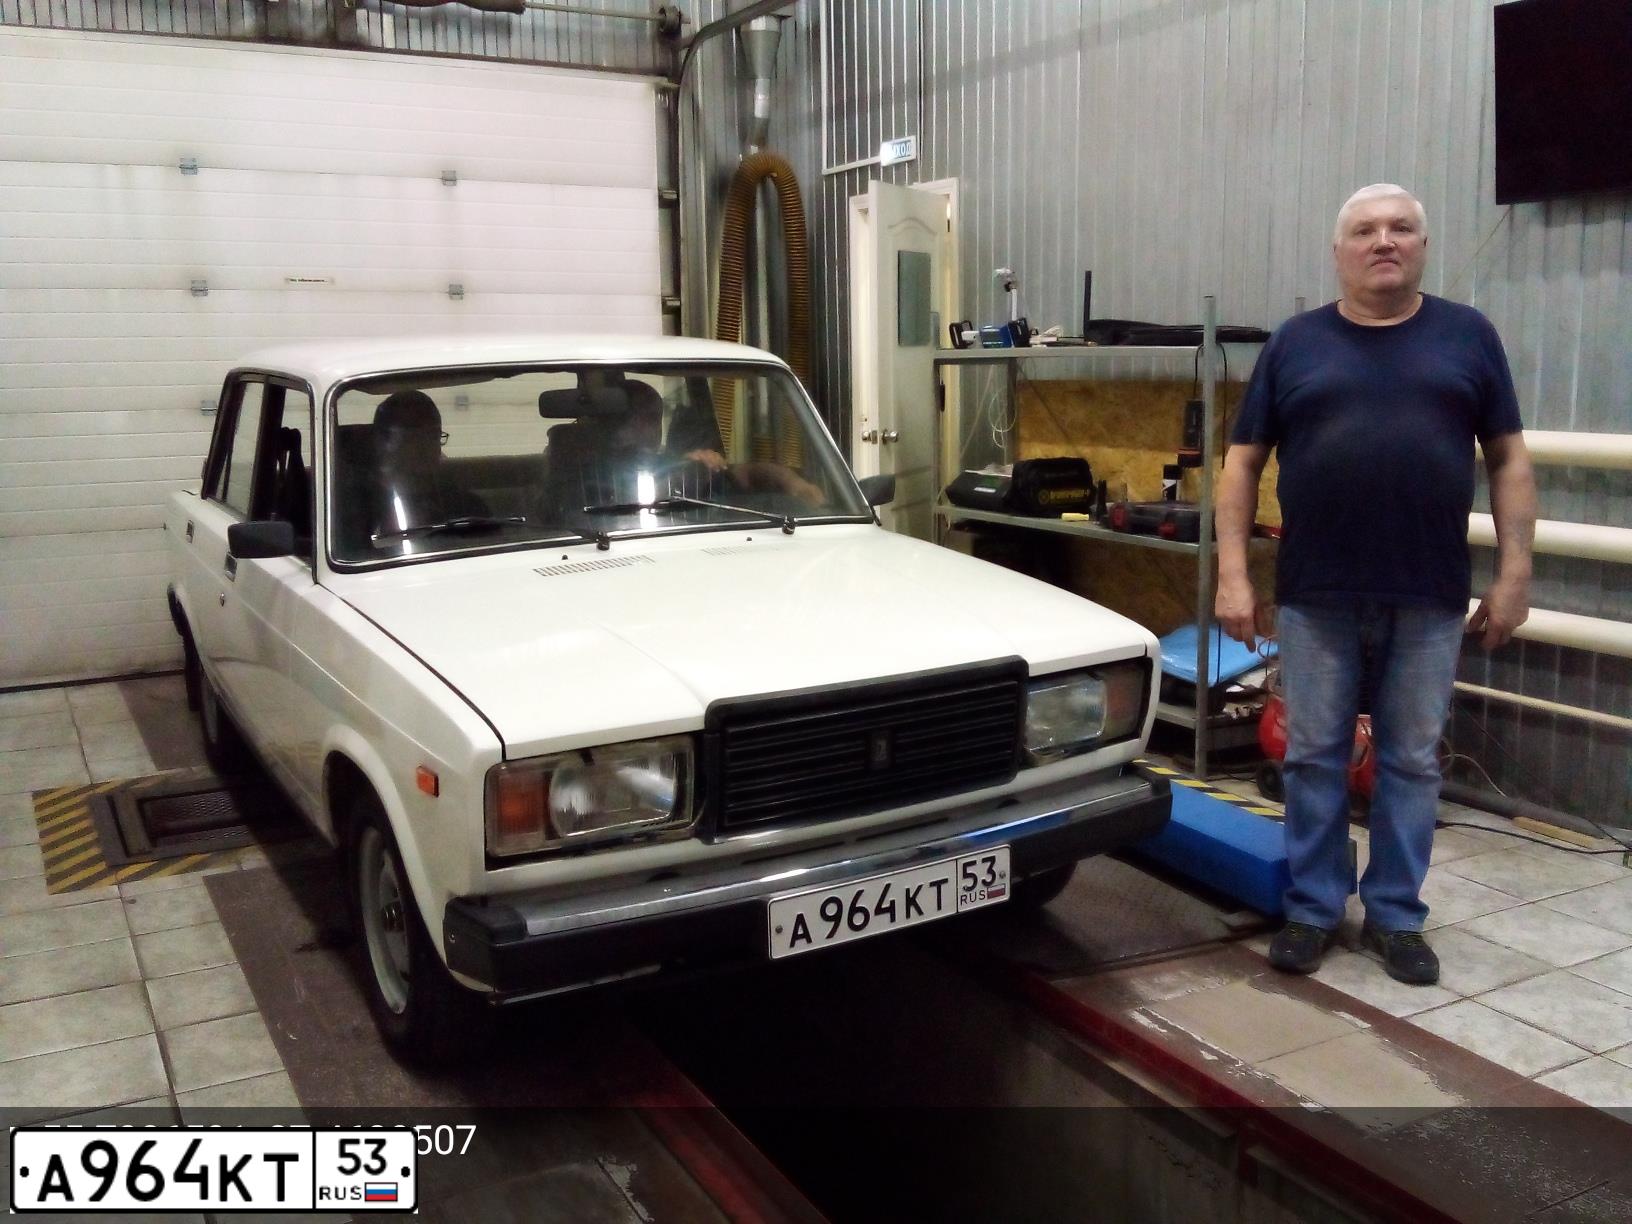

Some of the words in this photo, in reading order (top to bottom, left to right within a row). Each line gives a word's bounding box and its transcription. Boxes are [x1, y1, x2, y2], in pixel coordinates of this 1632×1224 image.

[789, 878, 949, 948] А964КТ
[962, 855, 997, 892] 53
[960, 890, 986, 906] RUS
